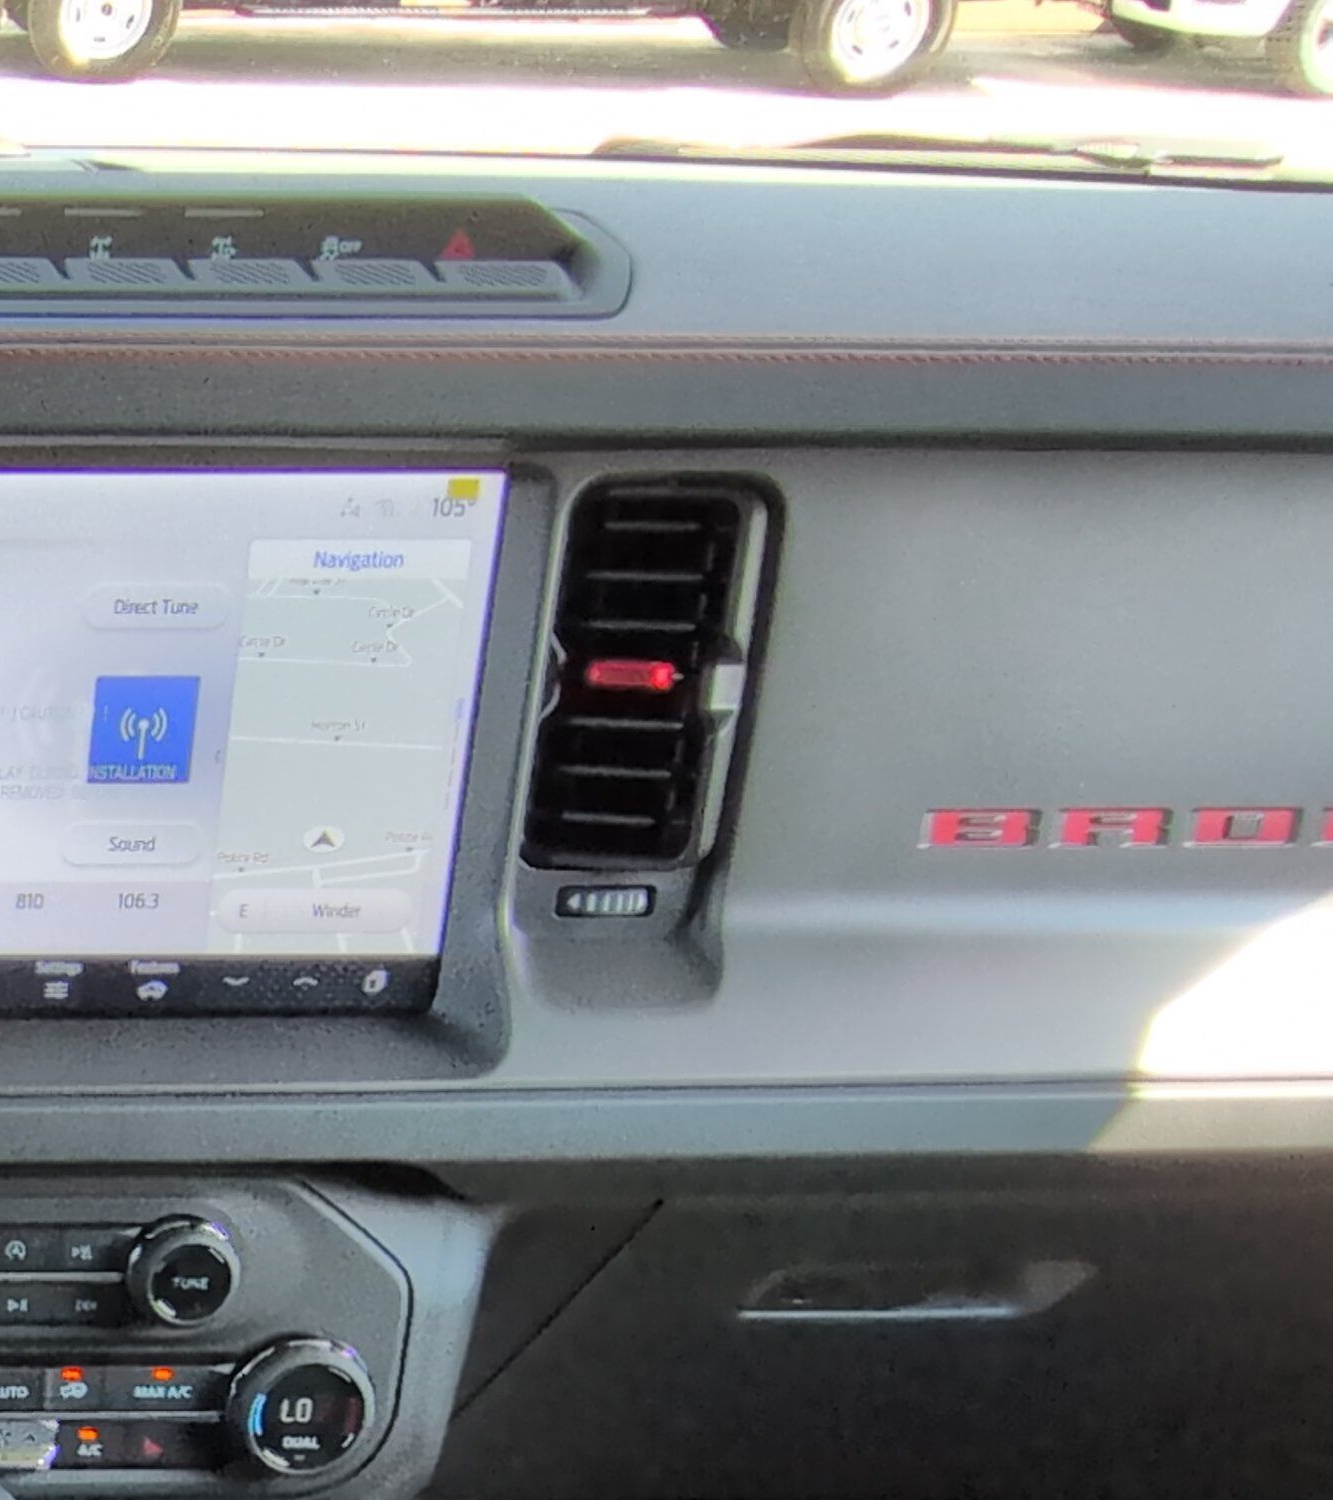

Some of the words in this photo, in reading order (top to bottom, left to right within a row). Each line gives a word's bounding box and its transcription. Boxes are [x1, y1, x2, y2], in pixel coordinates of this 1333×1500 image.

[313, 550, 405, 571] Navigation
[113, 598, 157, 616] Direct
[162, 598, 199, 616] Tune
[88, 764, 177, 780] NSTALLATION
[920, 807, 1333, 848] BRO
[107, 835, 157, 853] Sound
[15, 892, 45, 910] 810
[117, 892, 159, 910] 106.3
[238, 903, 250, 919] E
[311, 902, 362, 919] Winder
[171, 1276, 210, 1290] TUNE
[134, 1385, 167, 1399] MAX
[169, 1384, 194, 1400] A/C
[279, 1397, 314, 1424] LO
[77, 1443, 103, 1458] A/C
[282, 1435, 320, 1450] DUAL
